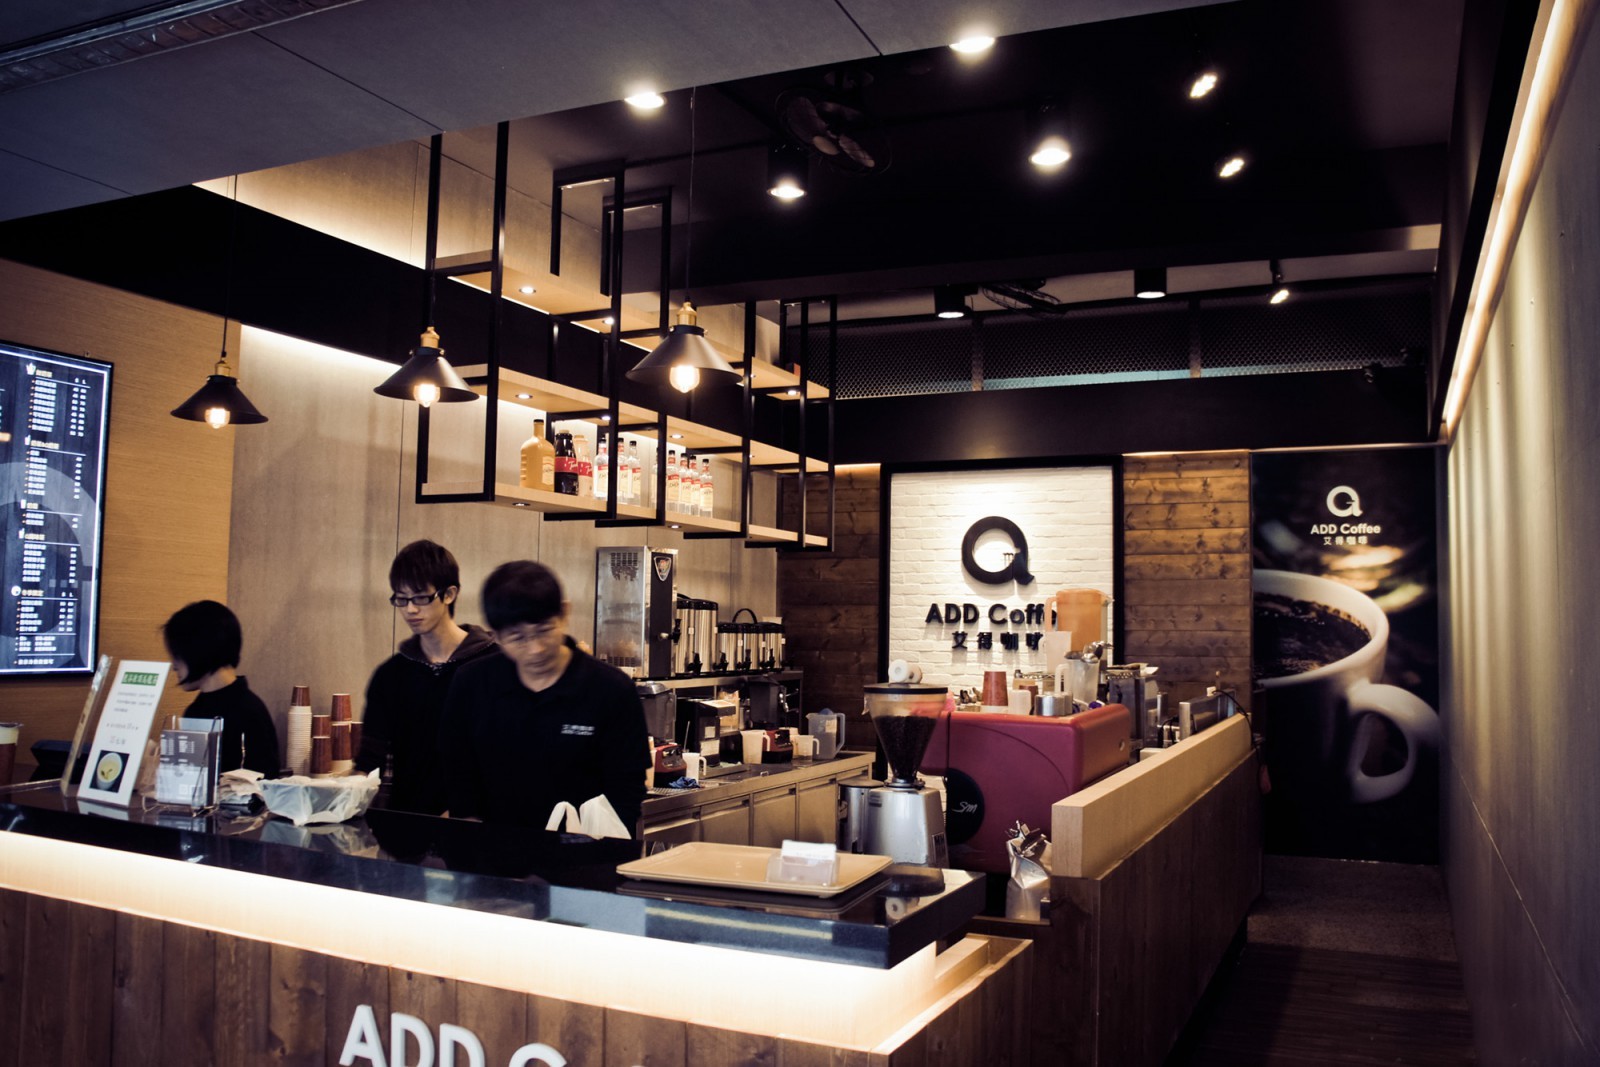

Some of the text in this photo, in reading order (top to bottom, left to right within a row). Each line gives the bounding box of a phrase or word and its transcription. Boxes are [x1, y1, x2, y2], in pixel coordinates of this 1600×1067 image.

[1310, 522, 1381, 535] ADD Coffee
[925, 603, 980, 624] ADD
[339, 1004, 485, 1067] ADD
